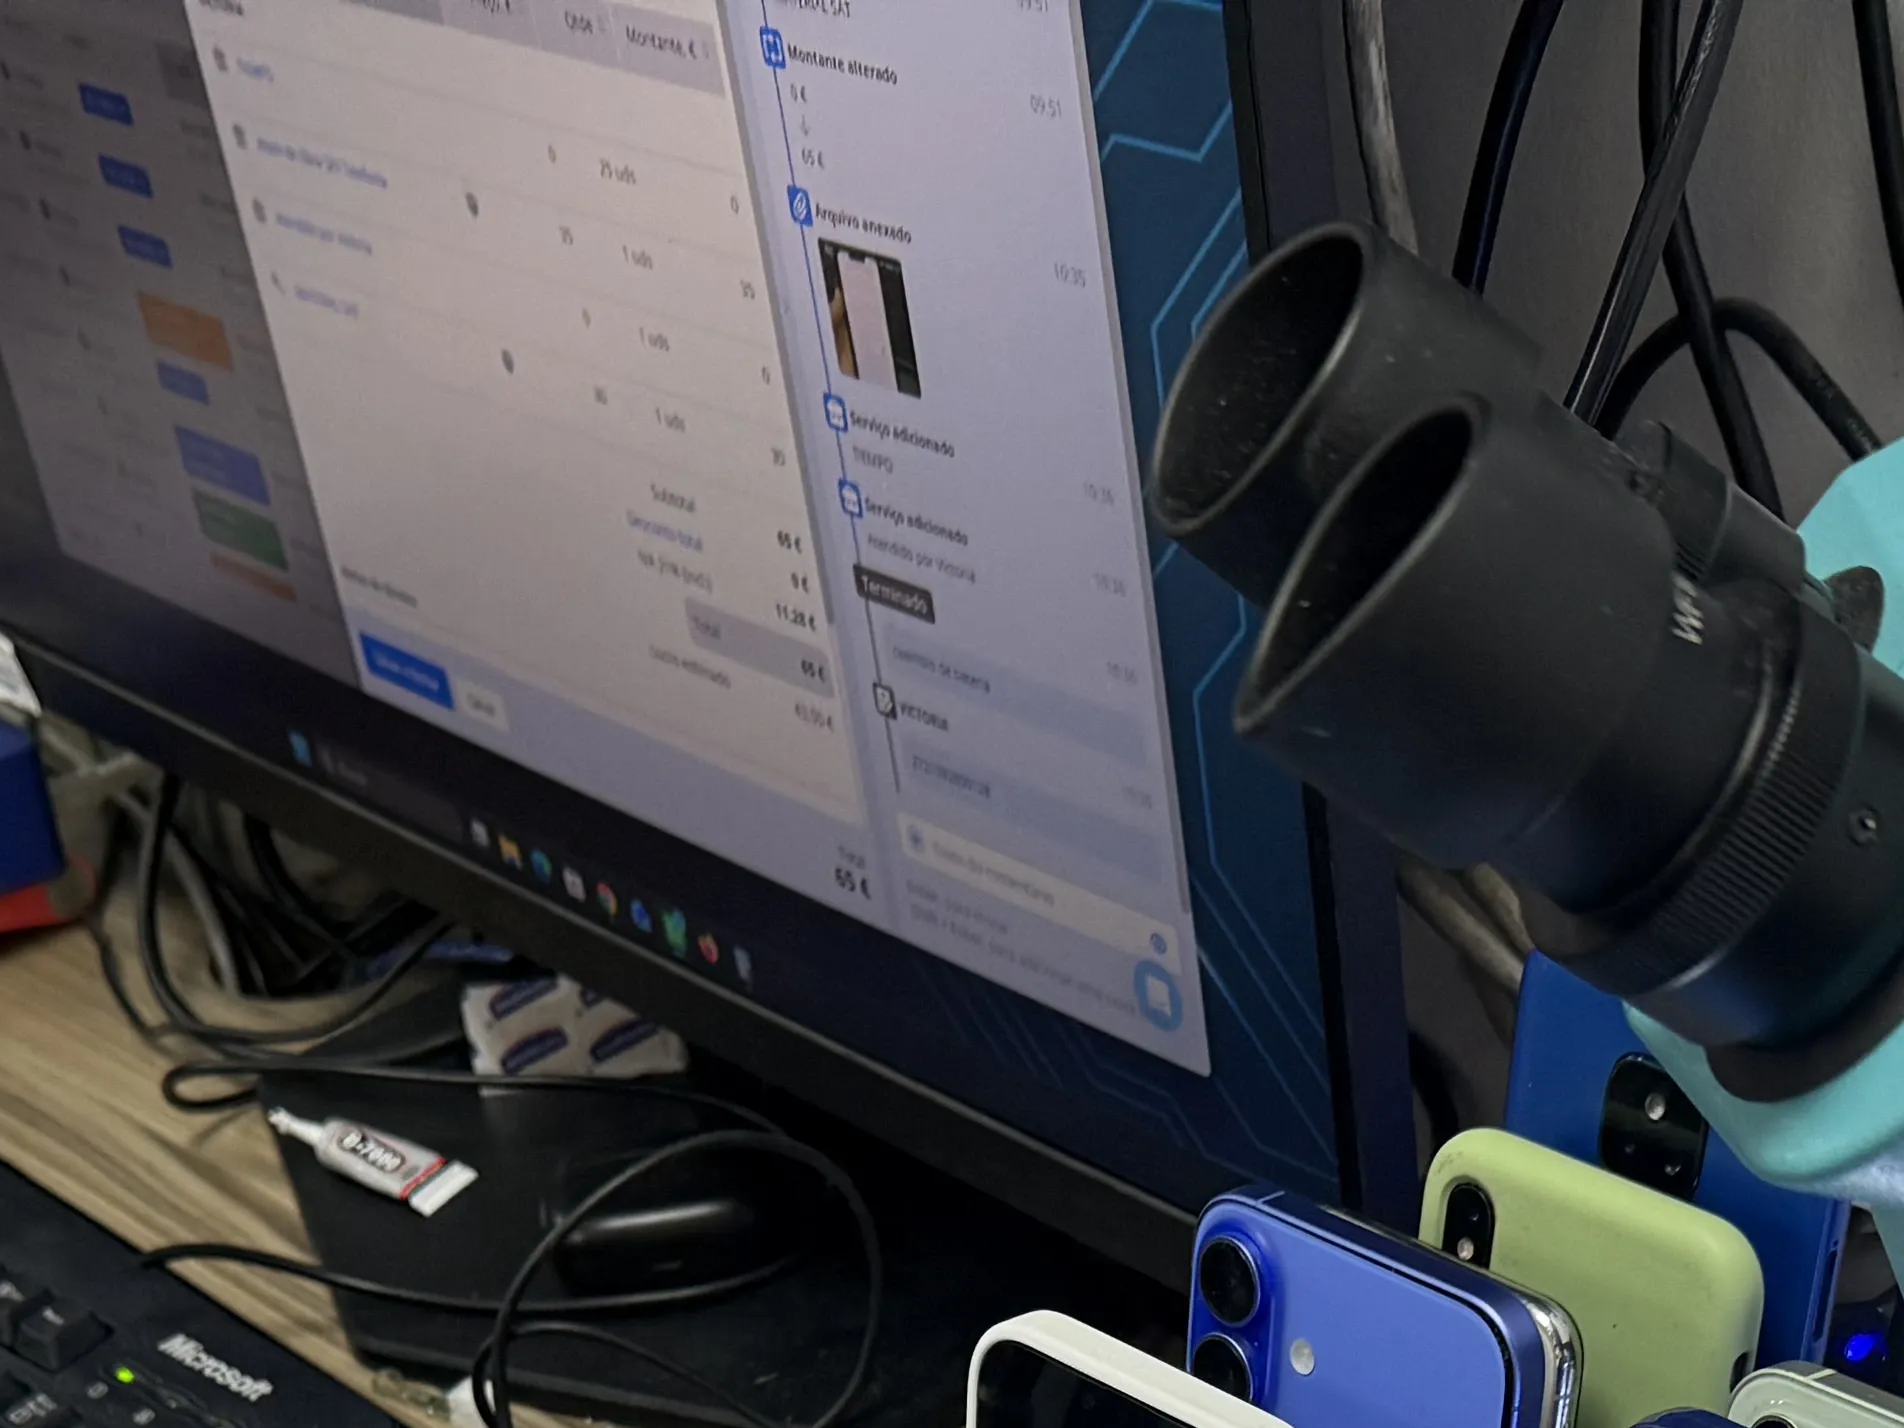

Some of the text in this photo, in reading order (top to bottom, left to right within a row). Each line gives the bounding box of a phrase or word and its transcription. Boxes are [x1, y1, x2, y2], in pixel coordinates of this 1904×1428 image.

[787, 42, 898, 85] Montante alterado
[815, 202, 913, 244] Arquivo anexado
[850, 411, 956, 458] Serviço adicionado
[864, 497, 969, 546] Serviço adicionado
[861, 575, 929, 616] Terminado
[834, 866, 857, 893] 65
[157, 1333, 275, 1404] Microsoft
